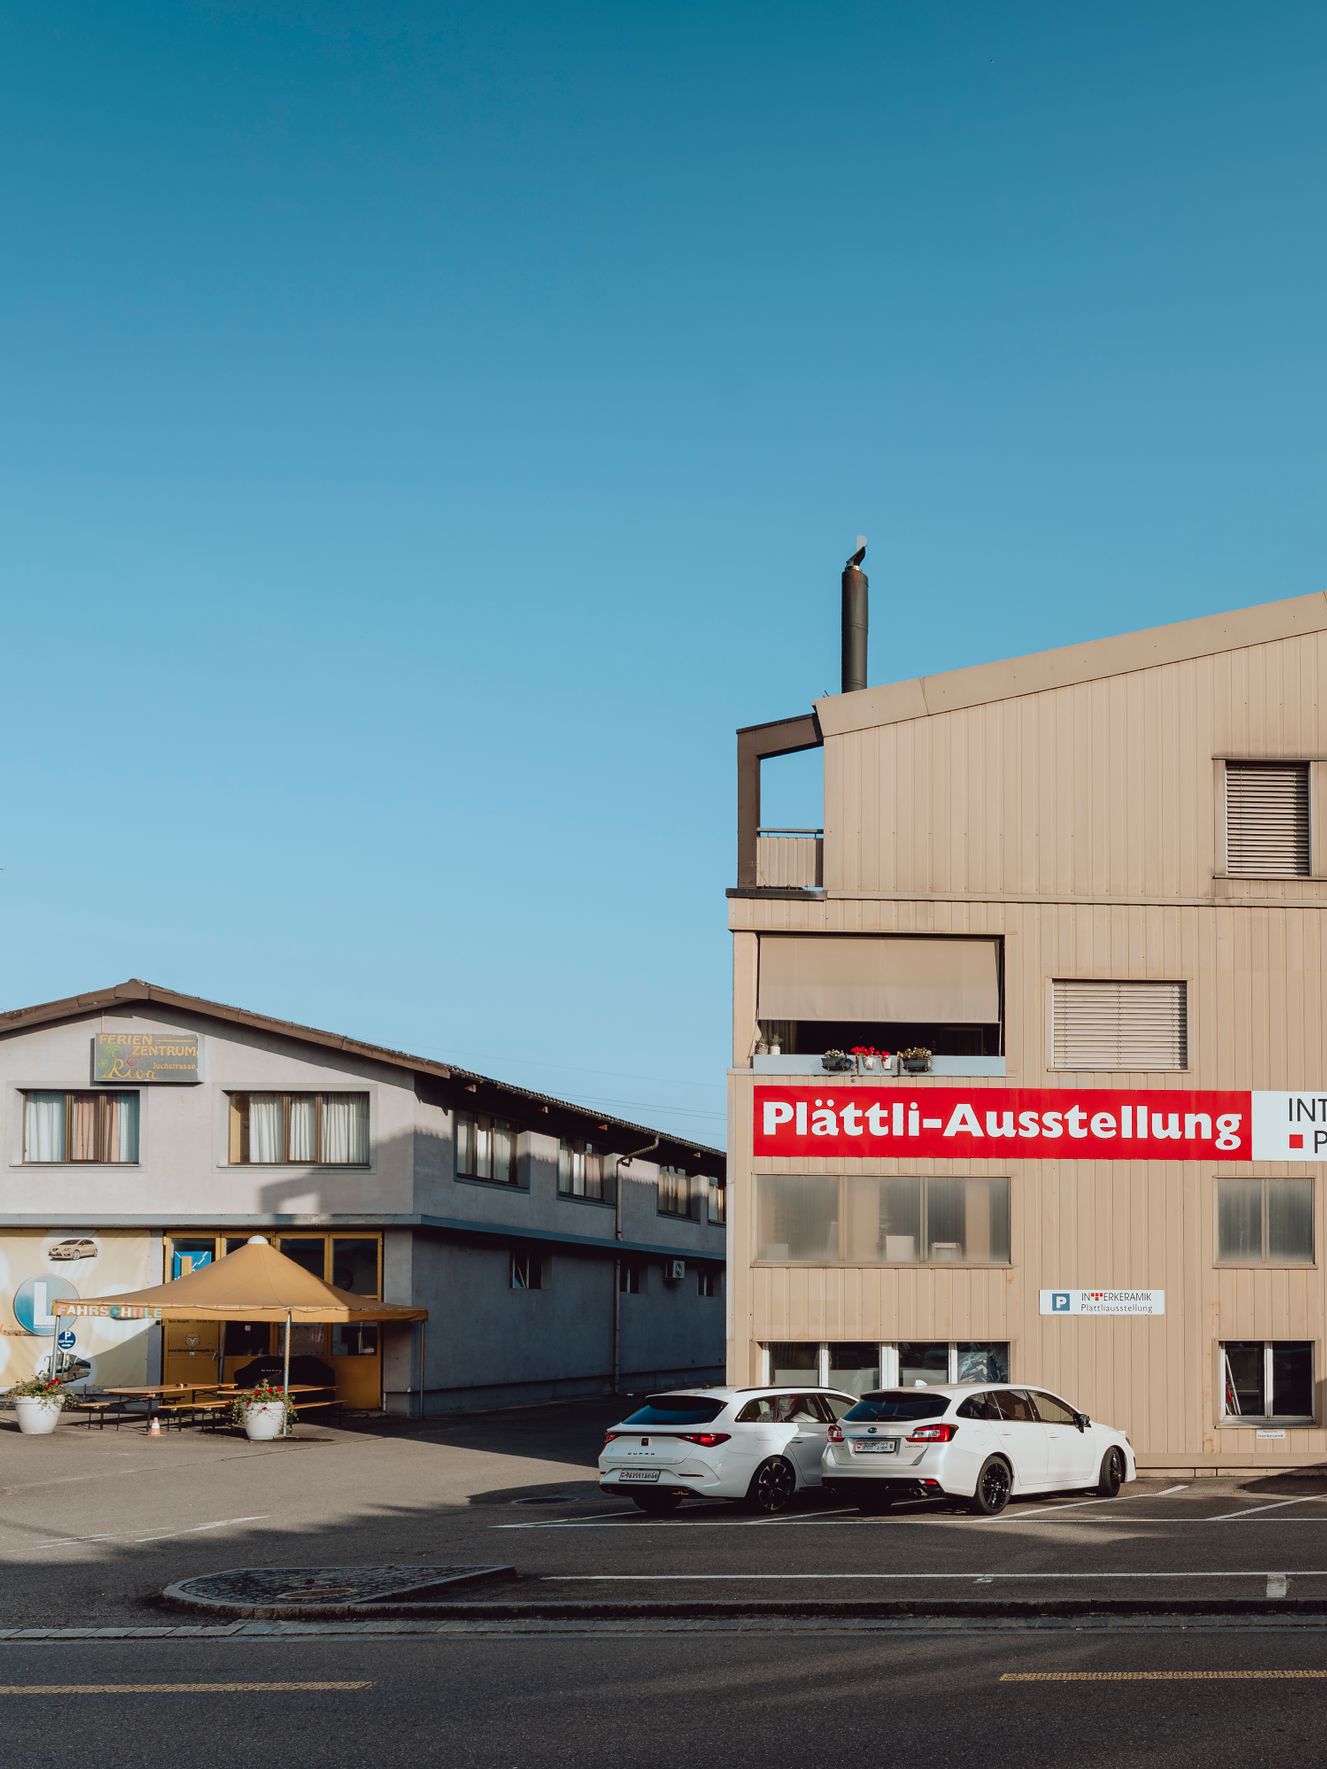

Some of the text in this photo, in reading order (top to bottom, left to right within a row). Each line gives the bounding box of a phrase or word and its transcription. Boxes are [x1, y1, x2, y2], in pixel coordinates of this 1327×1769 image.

[99, 1034, 153, 1045] FERIEN
[132, 1045, 196, 1057] ZENTRUM
[152, 1062, 197, 1070] Juchstrasse
[762, 1098, 1242, 1150] Plättli-Ausstellung
[1081, 1292, 1152, 1302] INTERKERAMIK
[57, 1303, 162, 1318] FAHRSCHULE
